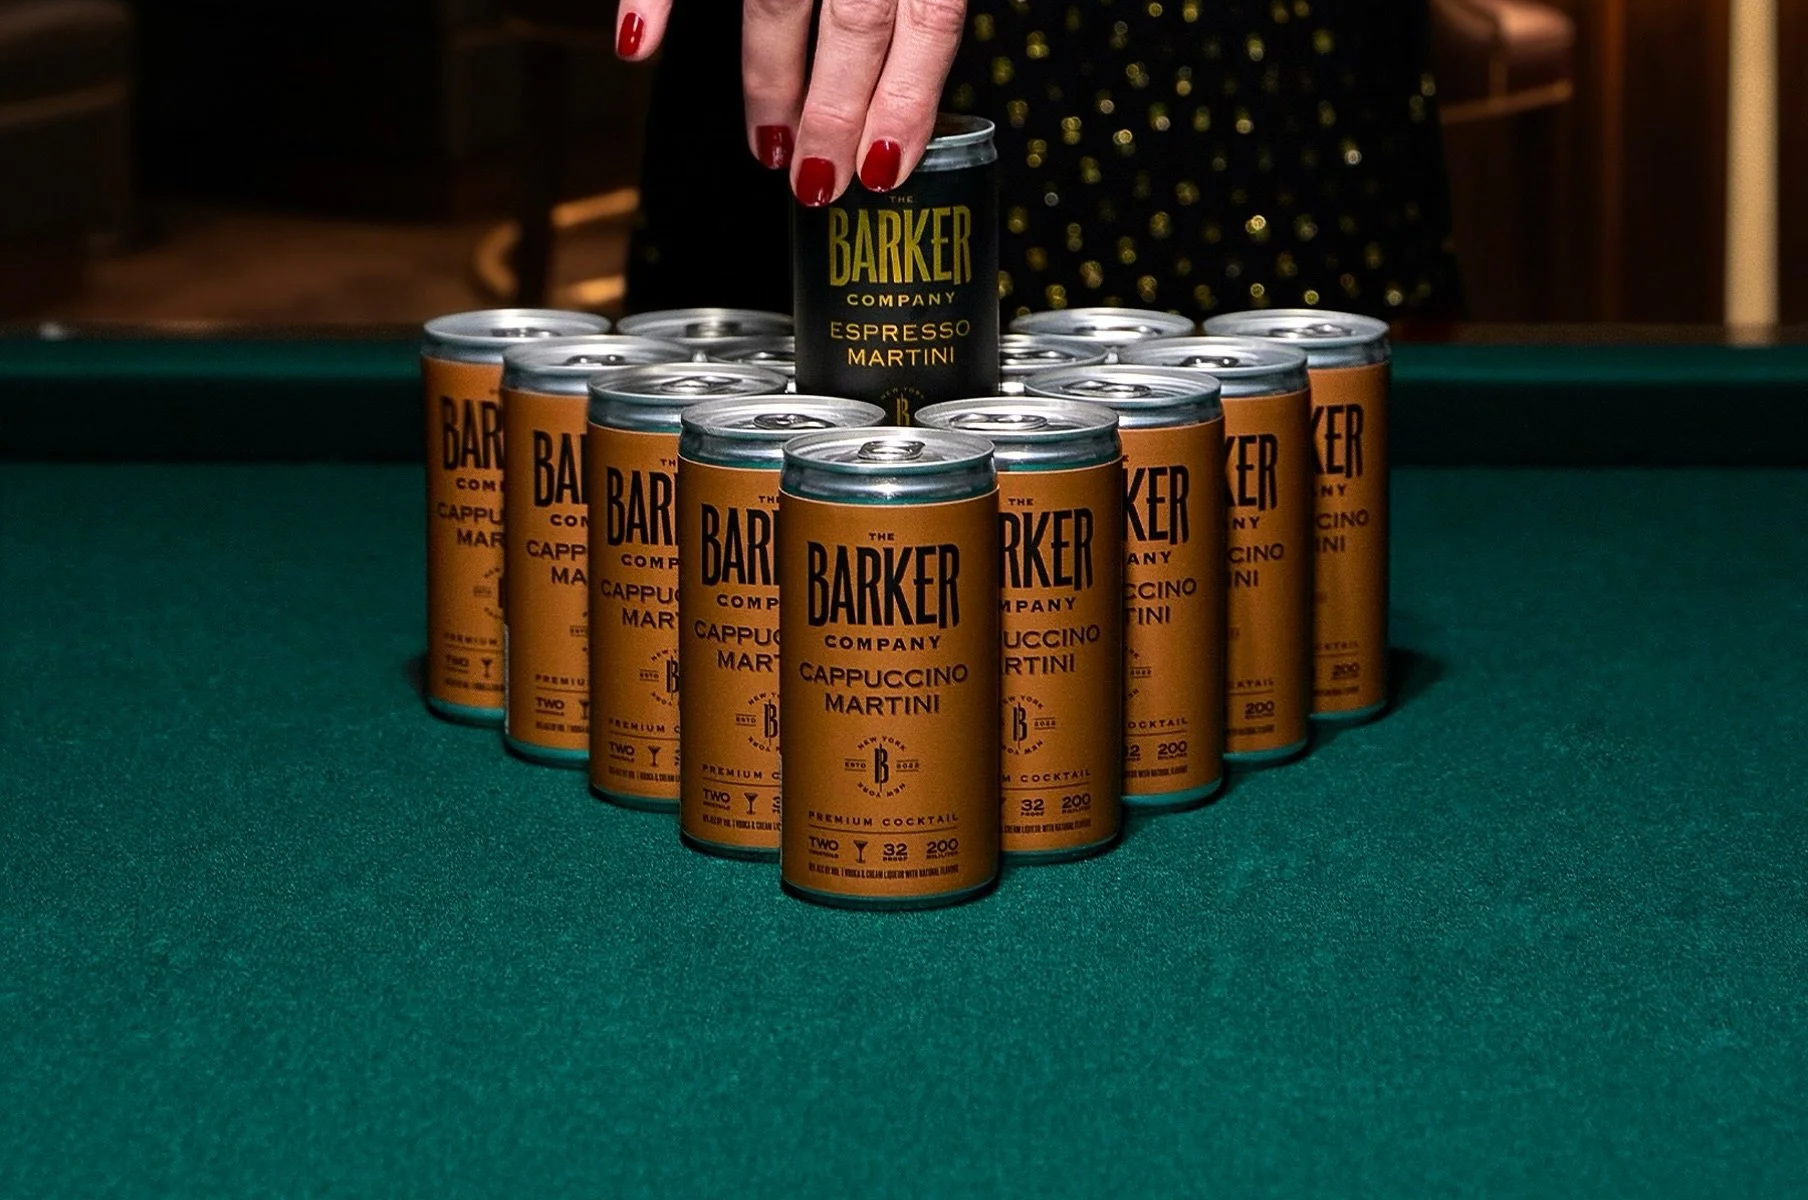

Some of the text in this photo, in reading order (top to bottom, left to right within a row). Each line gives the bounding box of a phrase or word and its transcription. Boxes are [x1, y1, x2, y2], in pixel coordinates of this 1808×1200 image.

[828, 205, 972, 287] BARKER
[846, 292, 956, 308] COMPANY
[830, 320, 971, 342] ESPRESSO
[847, 346, 955, 367] MARTINI
[441, 395, 504, 470] BAR
[660, 458, 678, 466] TH
[606, 465, 679, 546] BAR
[1008, 498, 1034, 506] THE
[1122, 465, 1189, 545] KER
[701, 503, 780, 586] BAR
[869, 532, 895, 541] THE
[998, 508, 1094, 591] RKER
[621, 554, 679, 569] COMP
[601, 579, 680, 604] CAPPU
[807, 541, 960, 629] BARKER
[1123, 578, 1197, 600] CCINO
[717, 594, 779, 610] COMP
[1000, 597, 1076, 613] MPANY
[1124, 606, 1170, 625] TINI
[694, 619, 780, 646] CAPPU
[1003, 624, 1100, 649] UCCINO
[825, 635, 941, 652] COMPANY
[1003, 654, 1076, 676] RTINI
[536, 674, 586, 686] PREMIU
[799, 662, 968, 689] CAPPUCCINO
[536, 697, 565, 710] TWO
[825, 691, 941, 716] MARTINI
[1245, 701, 1274, 714] 200
[608, 717, 665, 733] PREMIUM
[1128, 717, 1188, 729] OCKTAIL
[608, 741, 635, 756] TWO
[857, 735, 906, 751] NEW YORK
[1158, 740, 1188, 755] 200
[702, 763, 762, 779] PREMIUM
[874, 747, 889, 784] B
[1020, 768, 1091, 783] COCKTAIL
[703, 788, 731, 803] TWO
[1062, 793, 1091, 809] 200
[1021, 799, 1044, 812] 32
[808, 811, 959, 827] PREMIUM COCKTAIL
[808, 836, 839, 851] TWO
[883, 843, 908, 856] 32
[926, 838, 959, 854] 200
